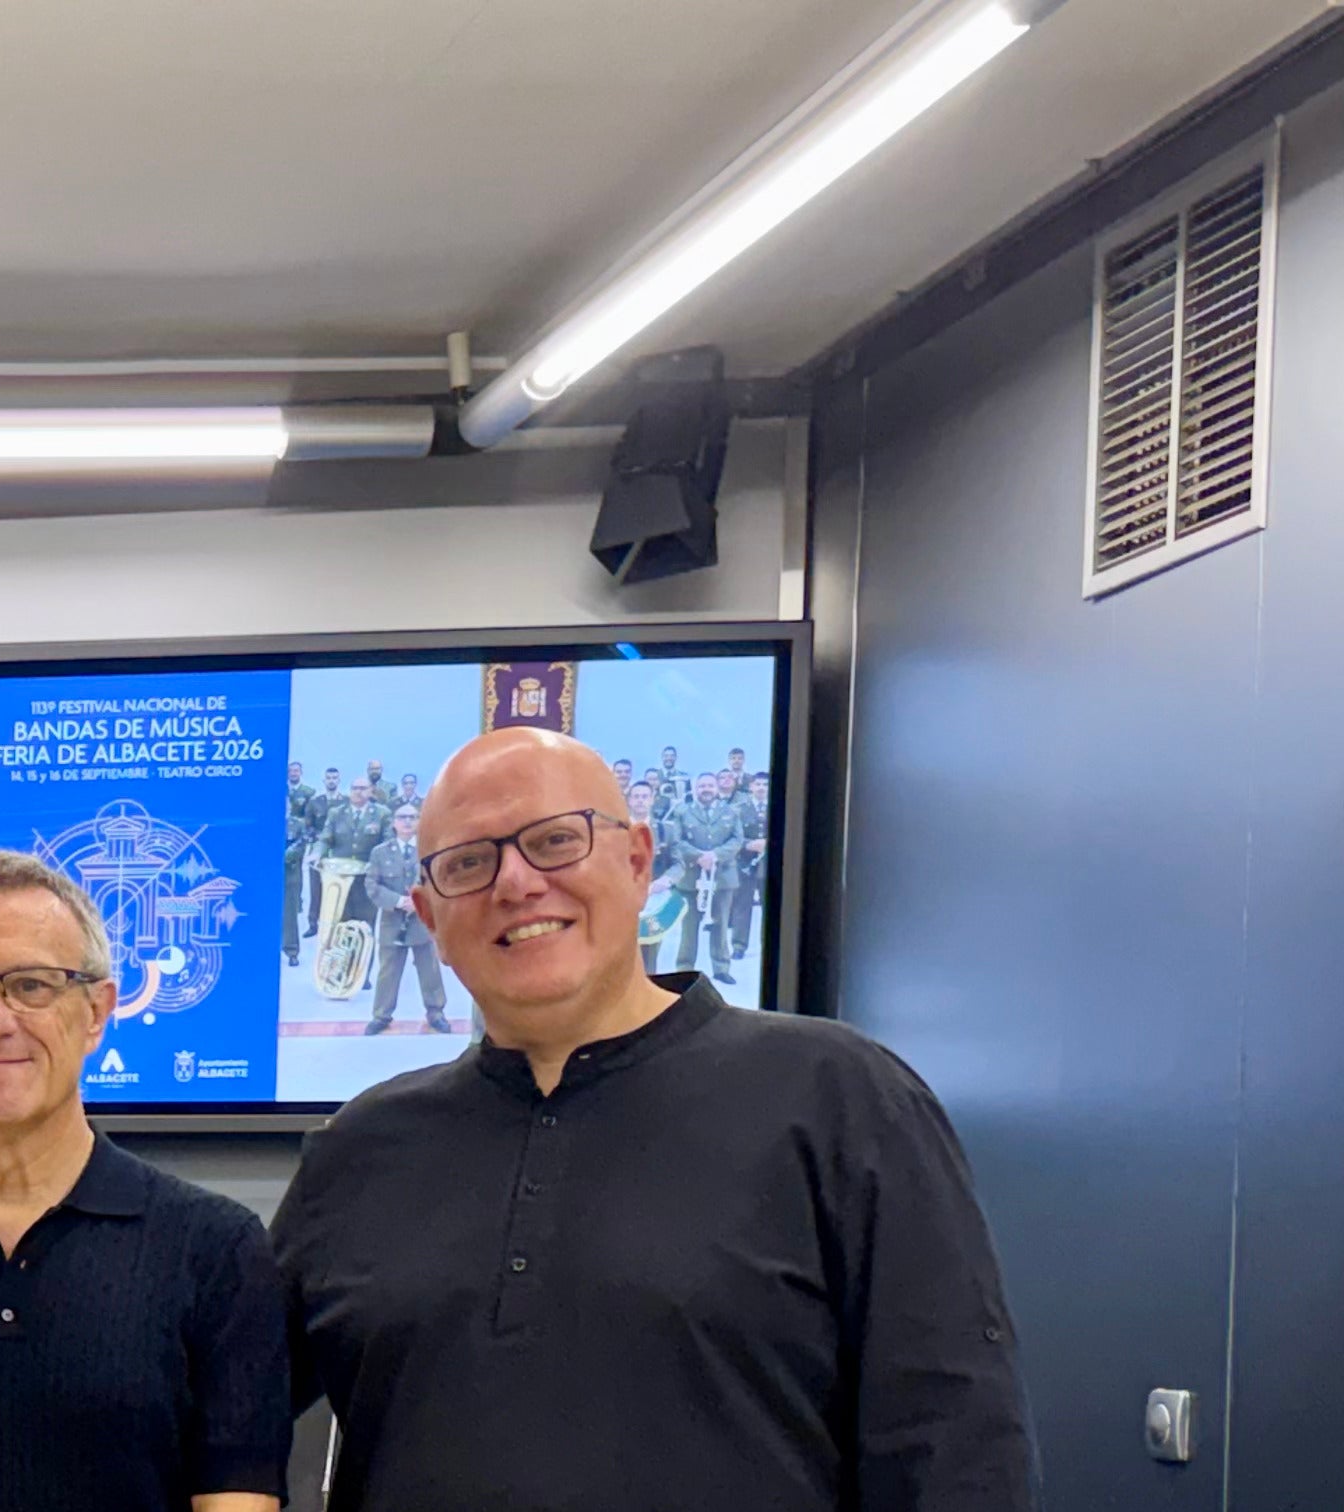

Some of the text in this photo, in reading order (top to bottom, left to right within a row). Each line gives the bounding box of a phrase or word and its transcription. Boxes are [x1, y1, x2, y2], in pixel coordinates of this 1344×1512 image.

[58, 699, 121, 714] FESTIVAL
[124, 697, 203, 713] NACIONAL
[206, 695, 227, 711] DE
[13, 711, 242, 742] BANDAS DE MÚSICA
[57, 743, 89, 764] DE
[92, 741, 207, 763] ALBACETE
[211, 738, 264, 761] 2026
[62, 769, 80, 781] DE
[80, 767, 150, 780] SEPTIEMBRE
[157, 766, 203, 779] TEATRO
[204, 765, 243, 778] CIRCO
[85, 1073, 140, 1084] ALBACETE
